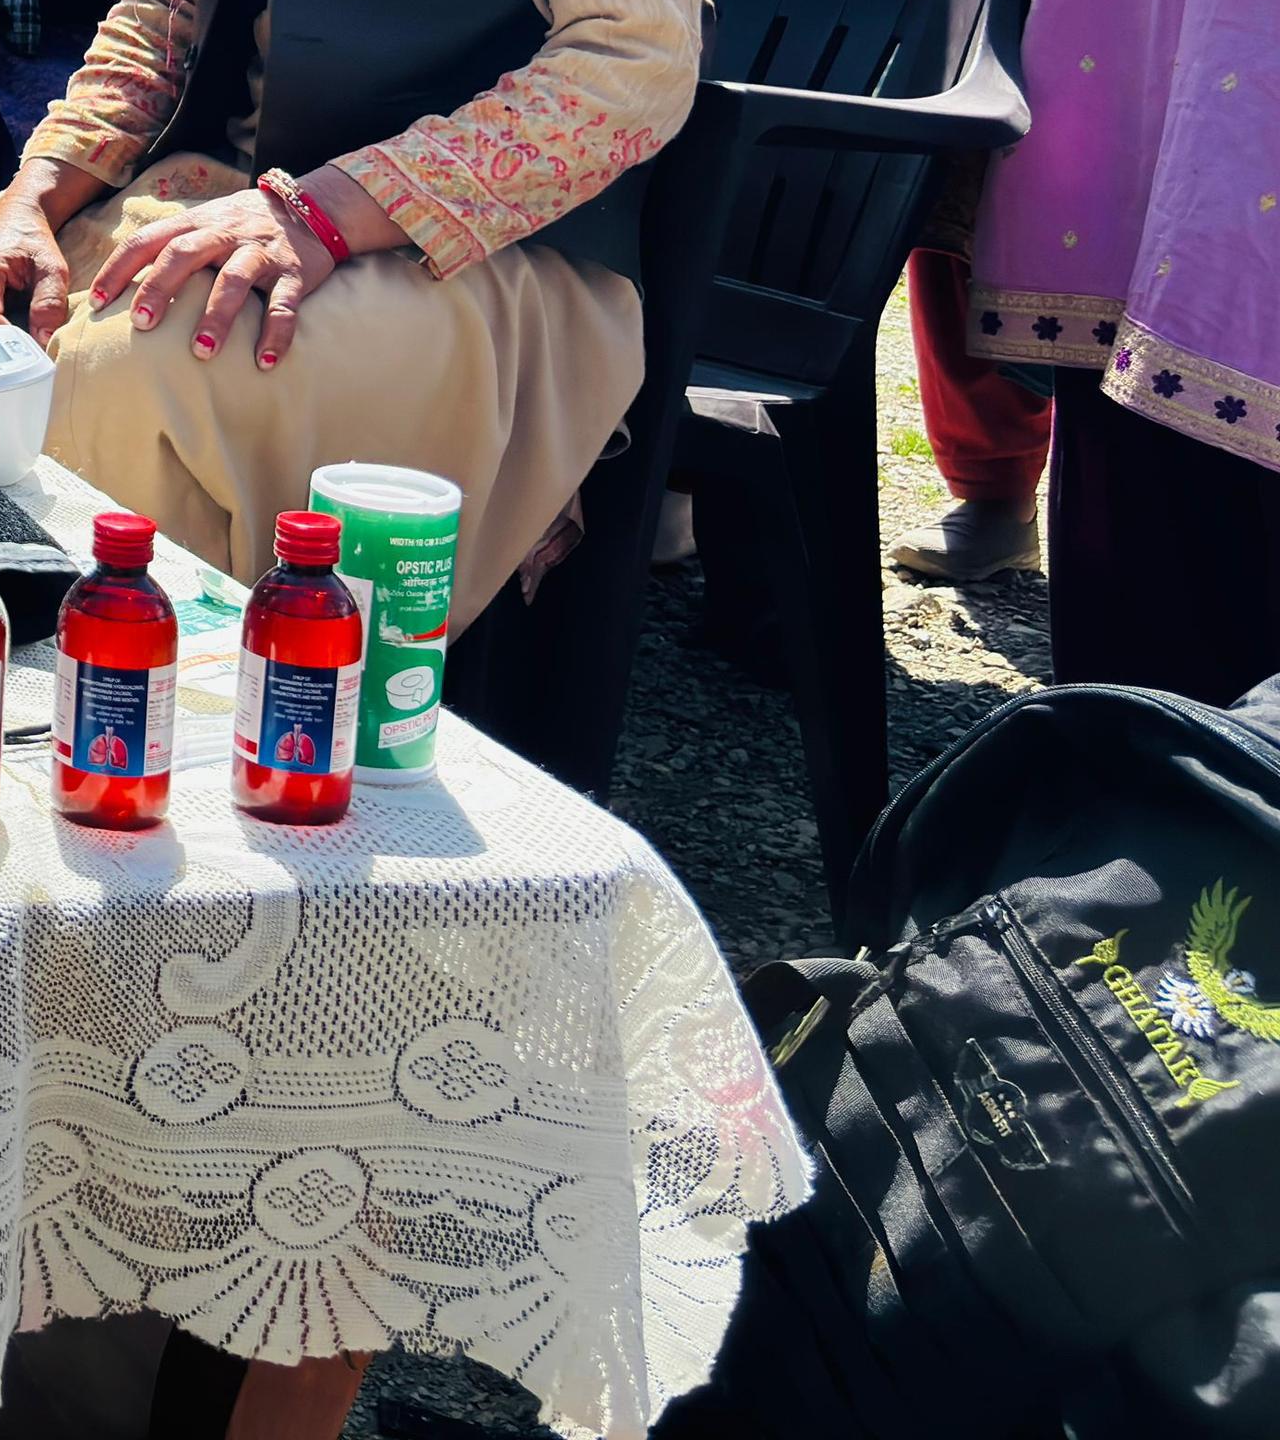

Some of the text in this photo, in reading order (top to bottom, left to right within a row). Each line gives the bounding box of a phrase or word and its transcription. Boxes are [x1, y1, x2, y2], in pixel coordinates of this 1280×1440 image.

[396, 560, 434, 575] OPSTIC
[383, 717, 420, 736] OPSTIC
[1104, 965, 1202, 1090] GHATAK
